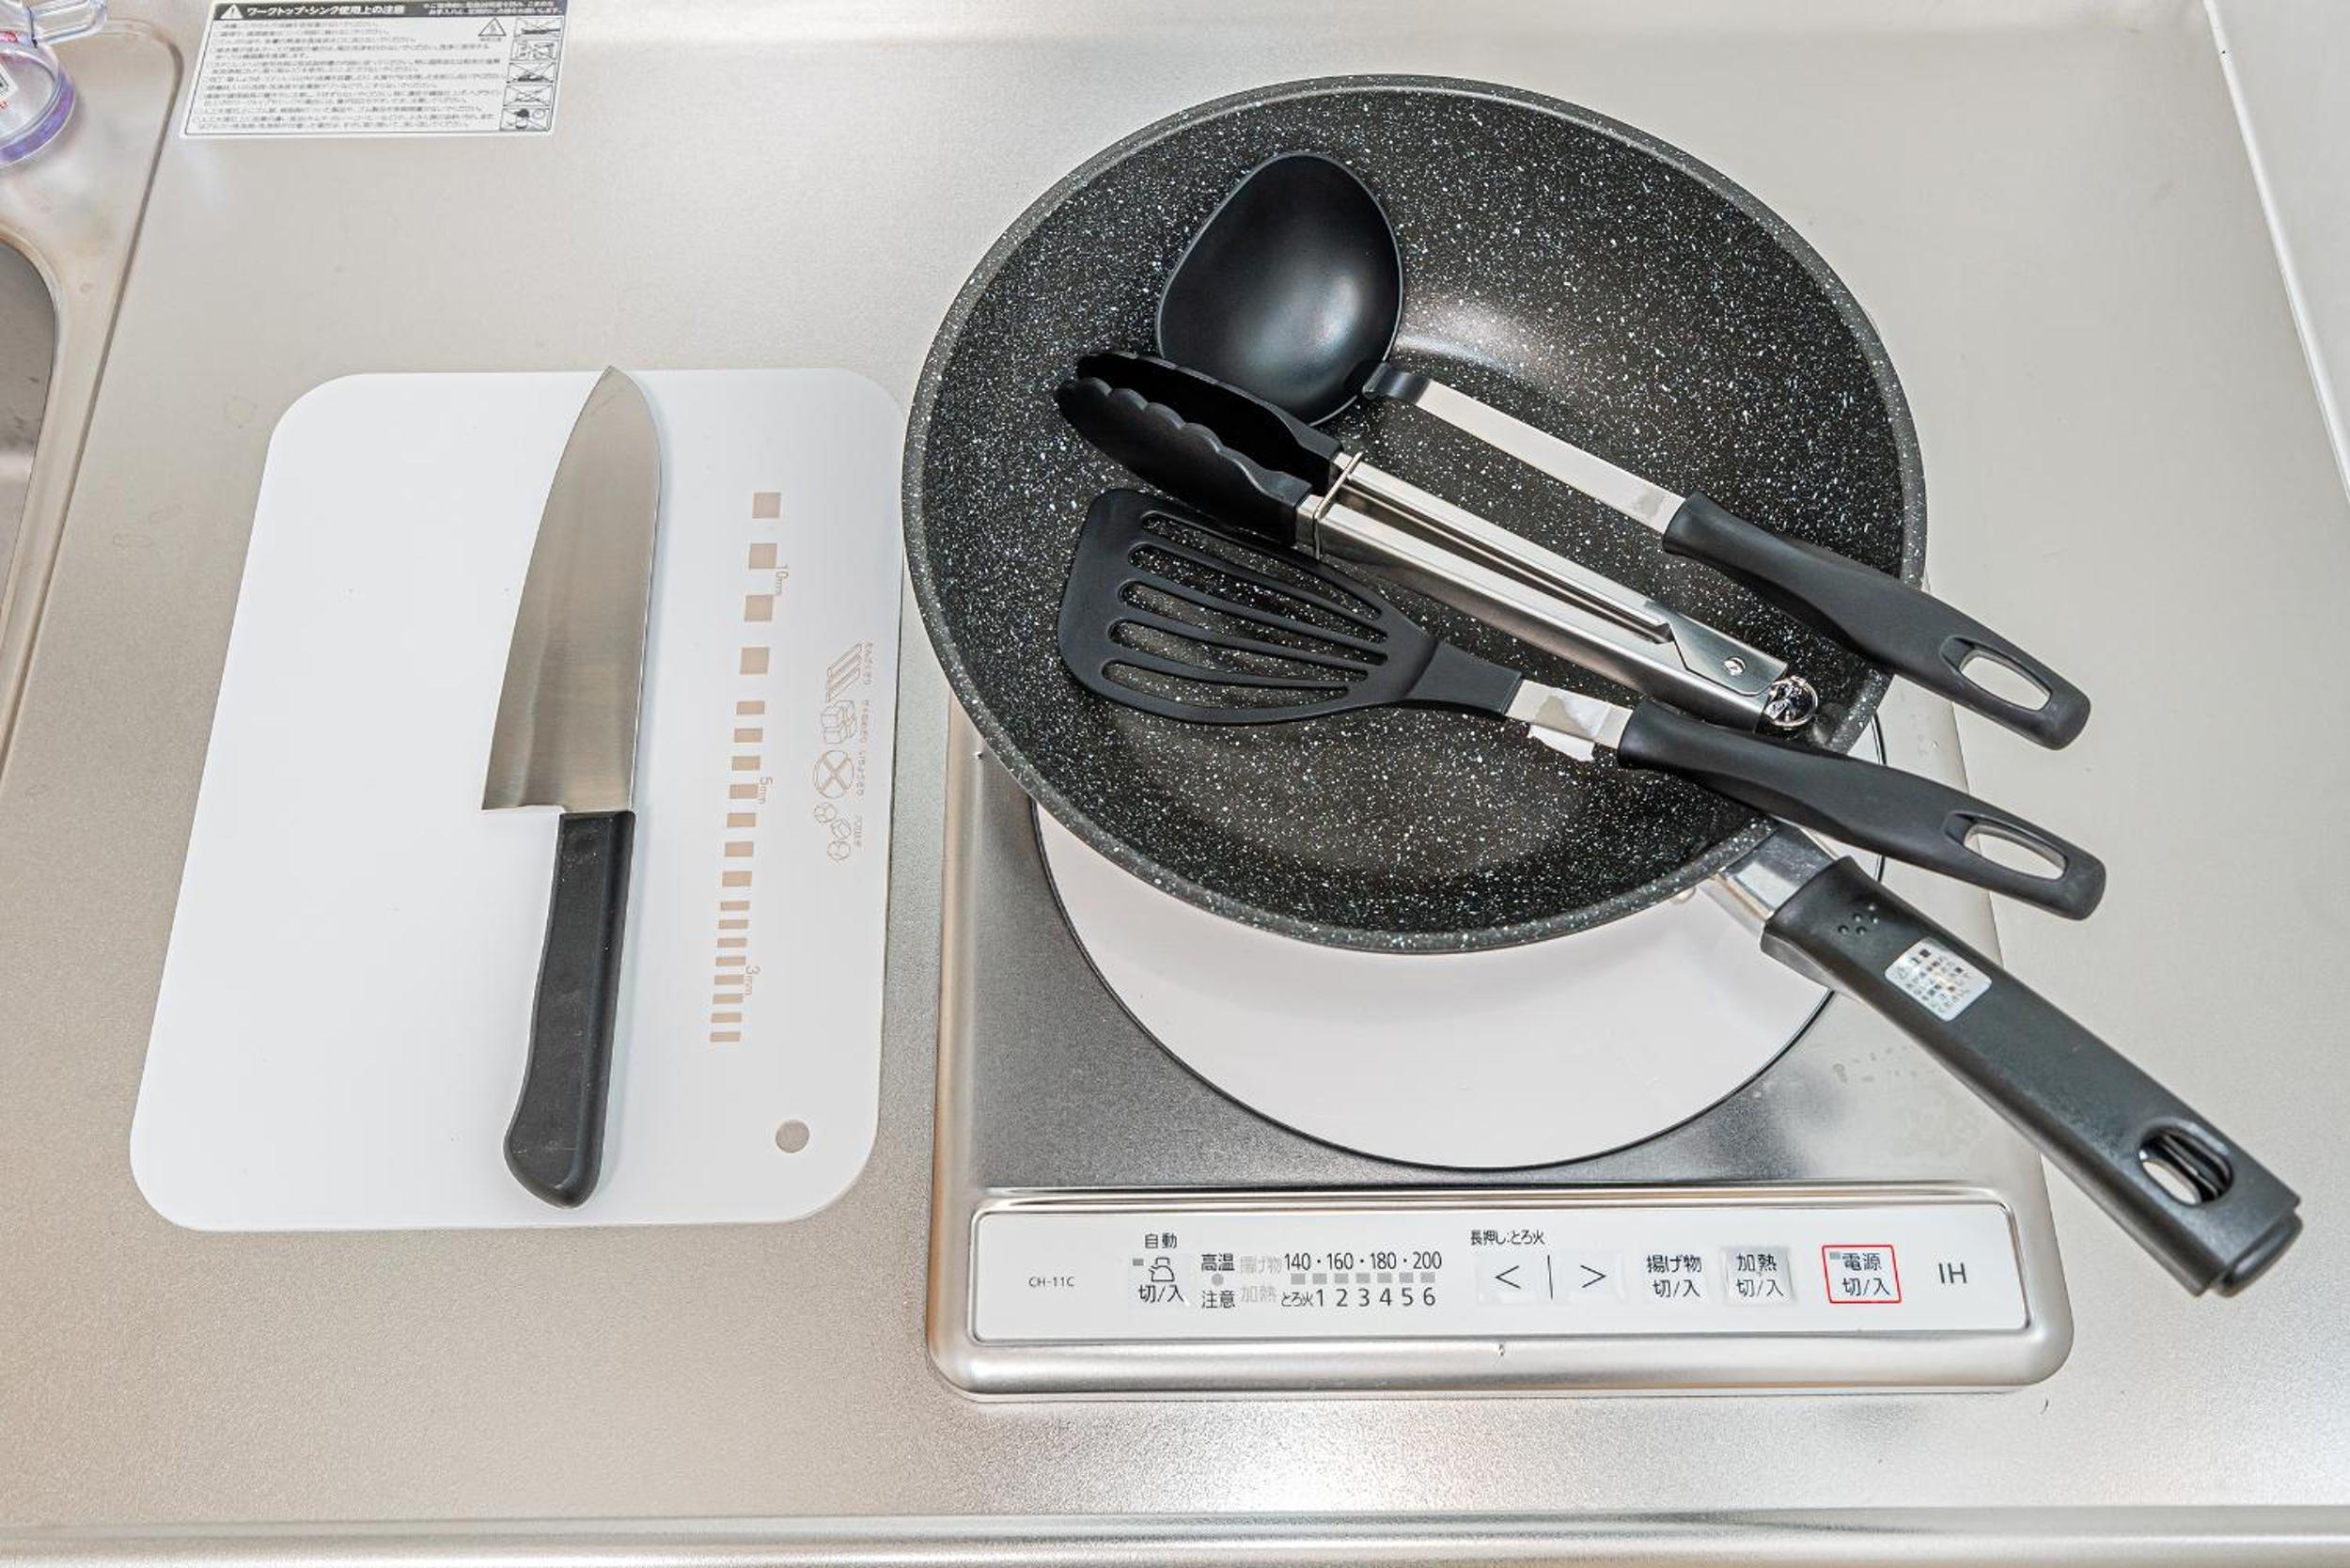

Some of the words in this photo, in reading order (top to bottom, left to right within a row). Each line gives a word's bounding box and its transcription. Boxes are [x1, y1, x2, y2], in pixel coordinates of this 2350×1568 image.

[759, 776, 773, 804] 5mm
[744, 965, 760, 996] 3mm
[1144, 1232, 1177, 1248] 自動
[1201, 1253, 1235, 1272] 高温
[1647, 1253, 1701, 1273] 揚げ物
[1736, 1253, 1777, 1271] 加熱
[1842, 1252, 1882, 1271] 電源
[1029, 1276, 1075, 1289] CH-11C
[1938, 1262, 1968, 1285] IH
[1137, 1284, 1184, 1303] 切/入
[1653, 1279, 1700, 1297] 切/入
[1736, 1278, 1783, 1297] 切/入
[1842, 1278, 1890, 1296] 切/入
[1202, 1290, 1235, 1309] 注意
[1281, 1291, 1314, 1308] とろ火
[1316, 1289, 1324, 1307] 1
[1336, 1288, 1348, 1307] 2
[1357, 1288, 1371, 1307] 3
[1379, 1288, 1392, 1307] 4
[1401, 1288, 1414, 1307] 5
[1423, 1288, 1435, 1307] 6
